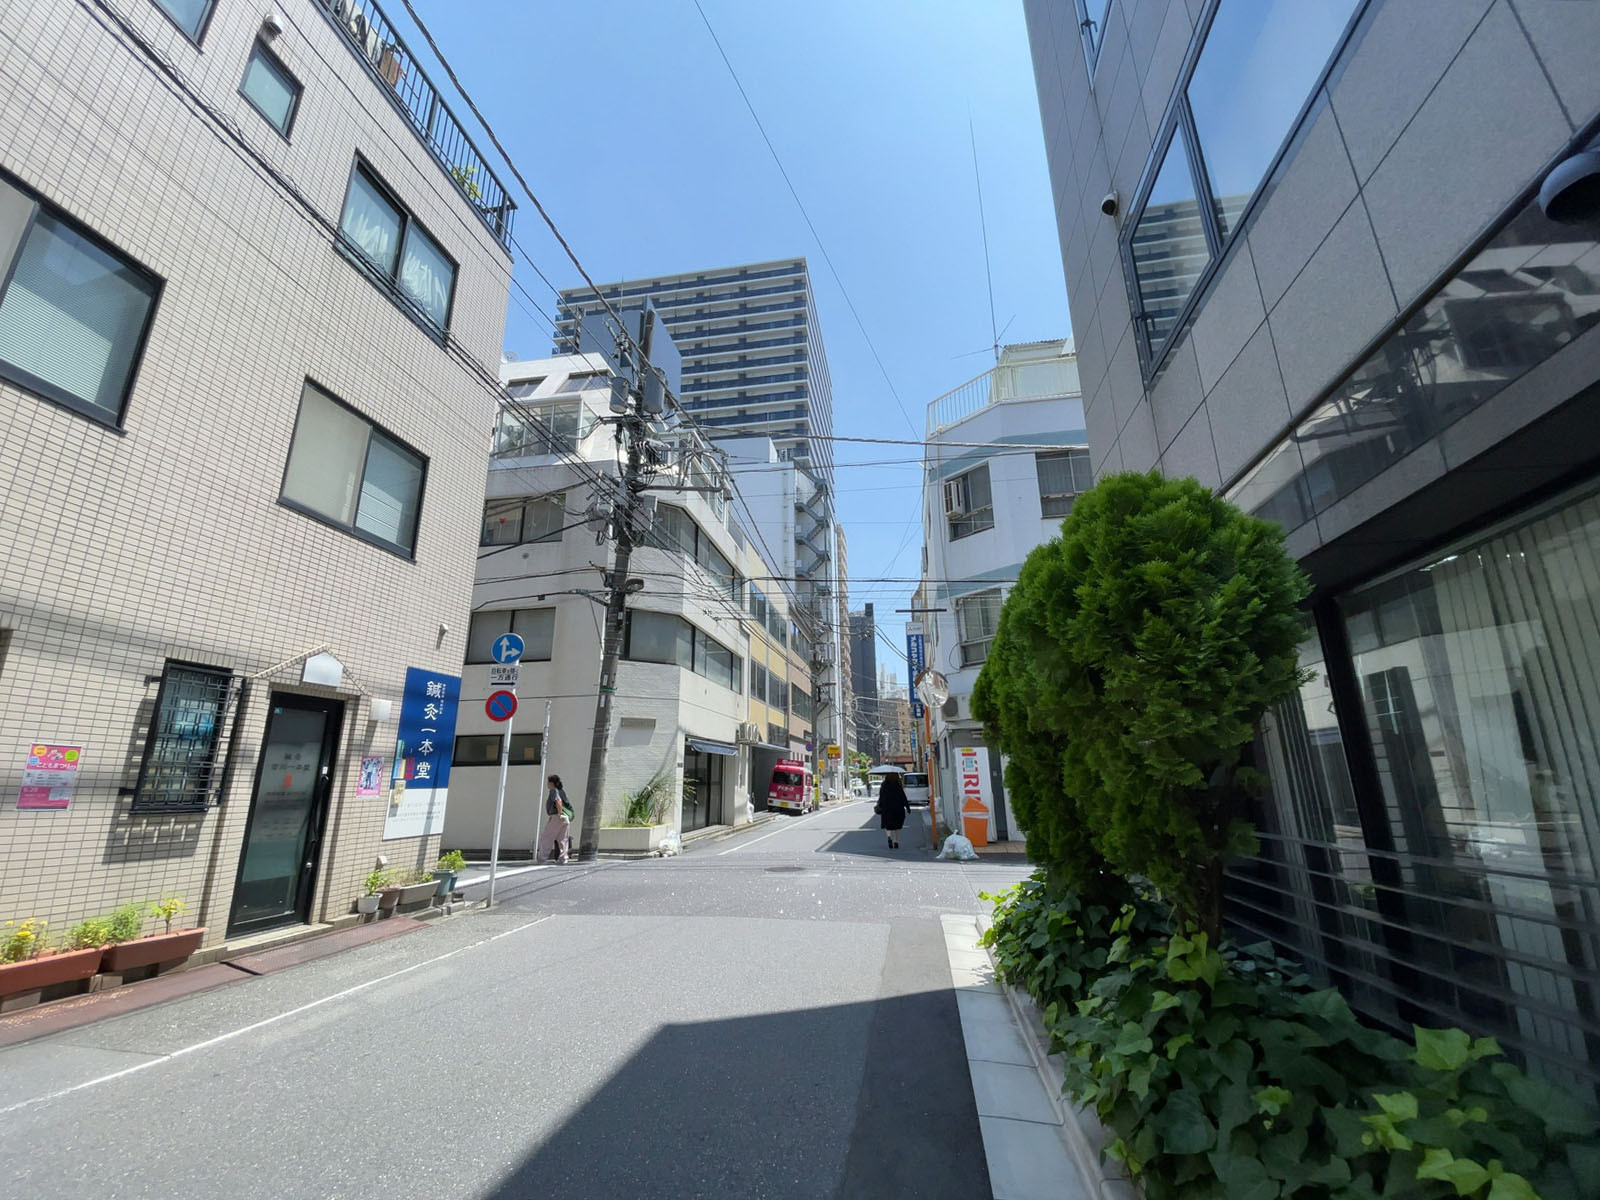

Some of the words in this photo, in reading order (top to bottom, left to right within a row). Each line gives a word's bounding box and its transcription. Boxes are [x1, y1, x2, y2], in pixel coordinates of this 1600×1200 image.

[414, 681, 442, 779] 鍼灸一本堂
